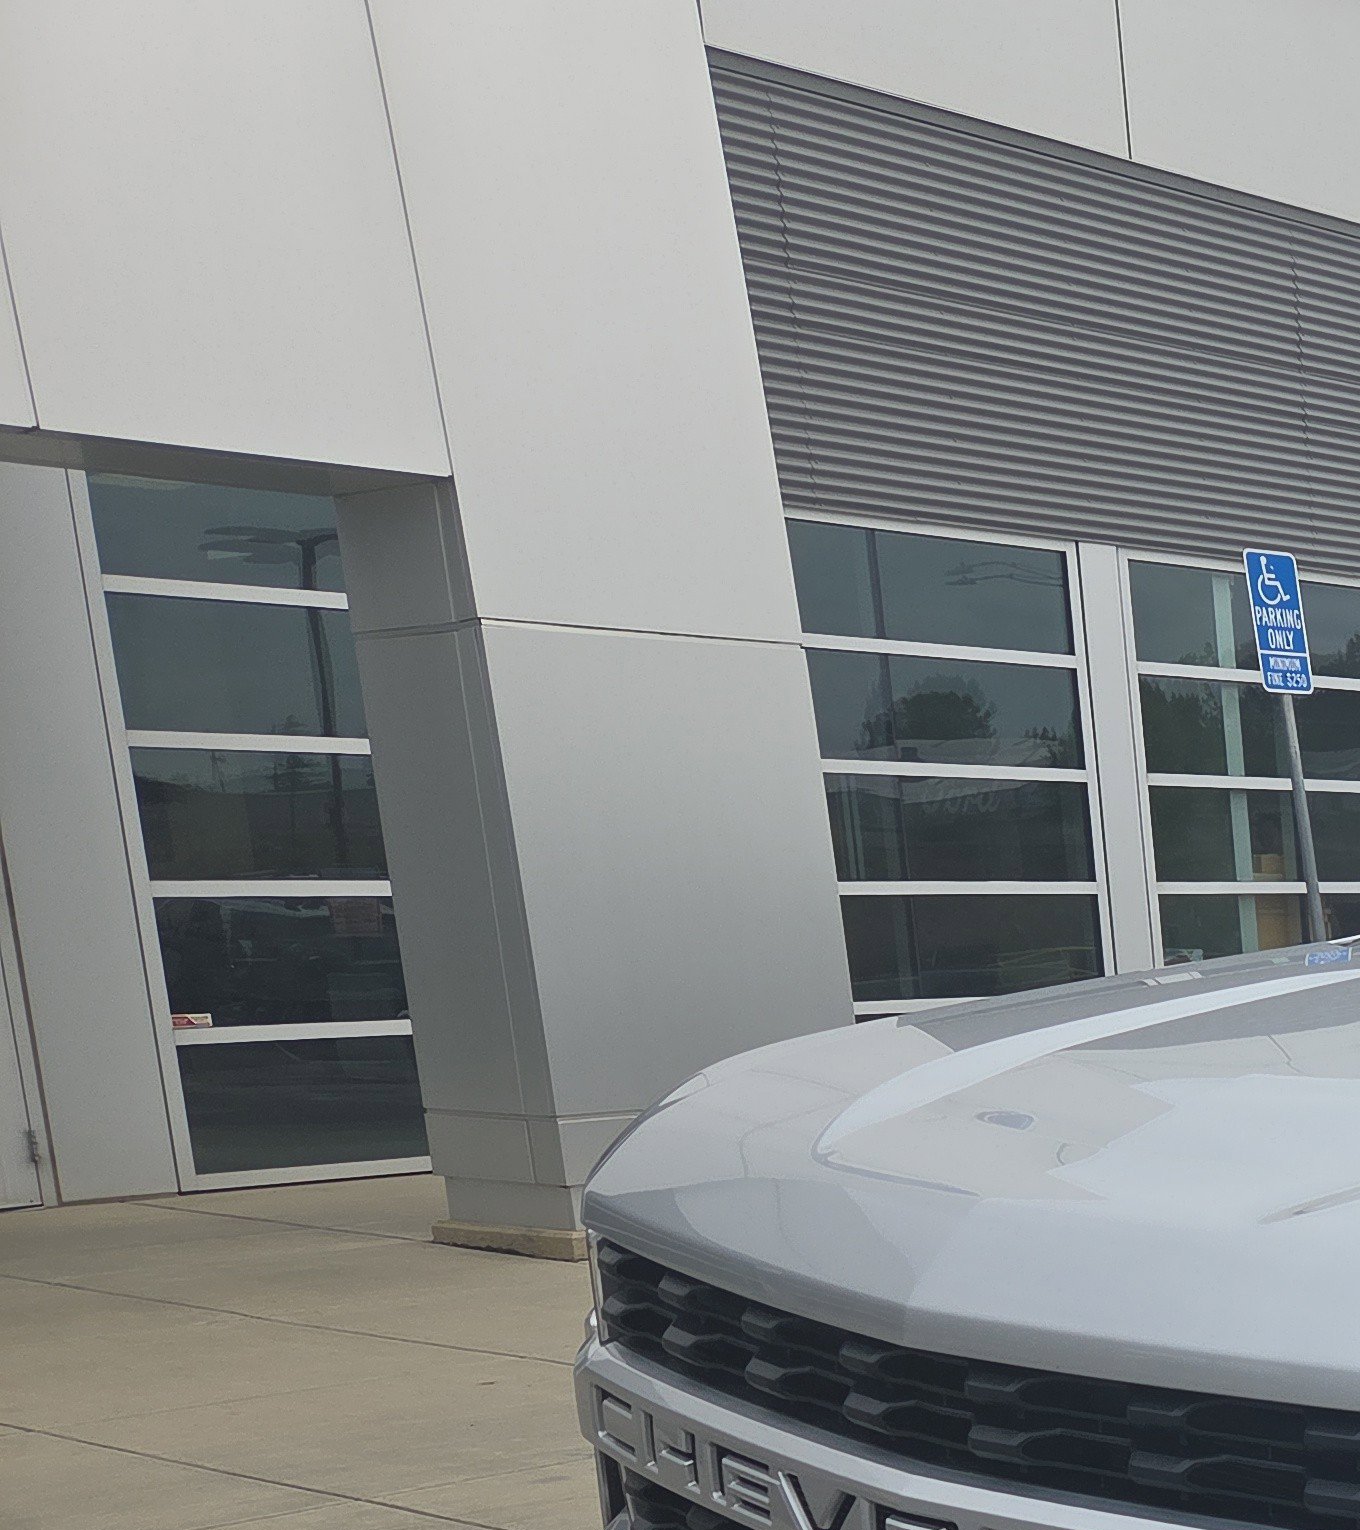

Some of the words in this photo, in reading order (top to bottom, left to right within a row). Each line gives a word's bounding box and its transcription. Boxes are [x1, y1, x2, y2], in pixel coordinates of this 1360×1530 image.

[1255, 606, 1301, 629] PARKING
[1267, 628, 1294, 650] ONLY
[1286, 672, 1307, 687] $250
